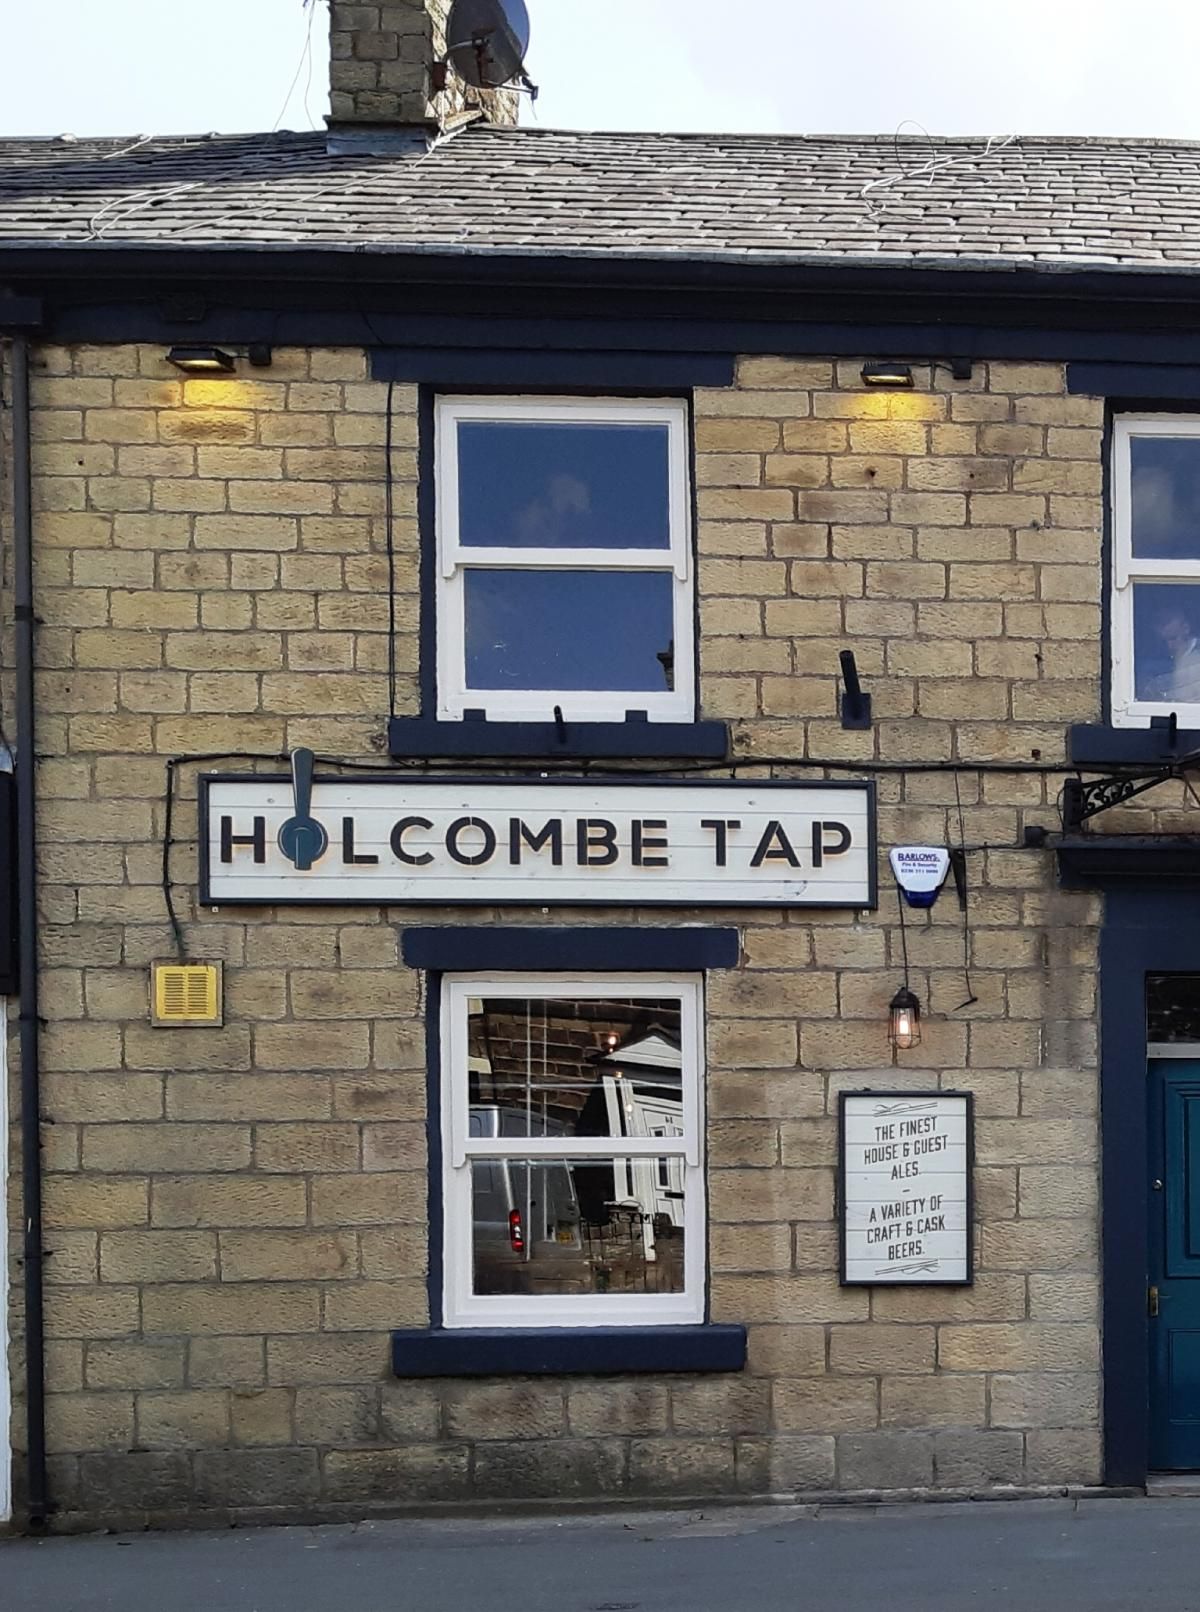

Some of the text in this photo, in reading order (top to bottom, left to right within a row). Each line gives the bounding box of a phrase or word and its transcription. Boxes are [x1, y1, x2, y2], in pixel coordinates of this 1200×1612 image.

[700, 818, 853, 869] TAP
[875, 1115, 938, 1142] THE FINEST
[864, 1134, 948, 1165] HOUSE & GUEST
[869, 1194, 943, 1223] A VARIETY OF
[867, 1214, 946, 1244] CRAFT & CASK
[888, 1239, 926, 1261] BEERS.
